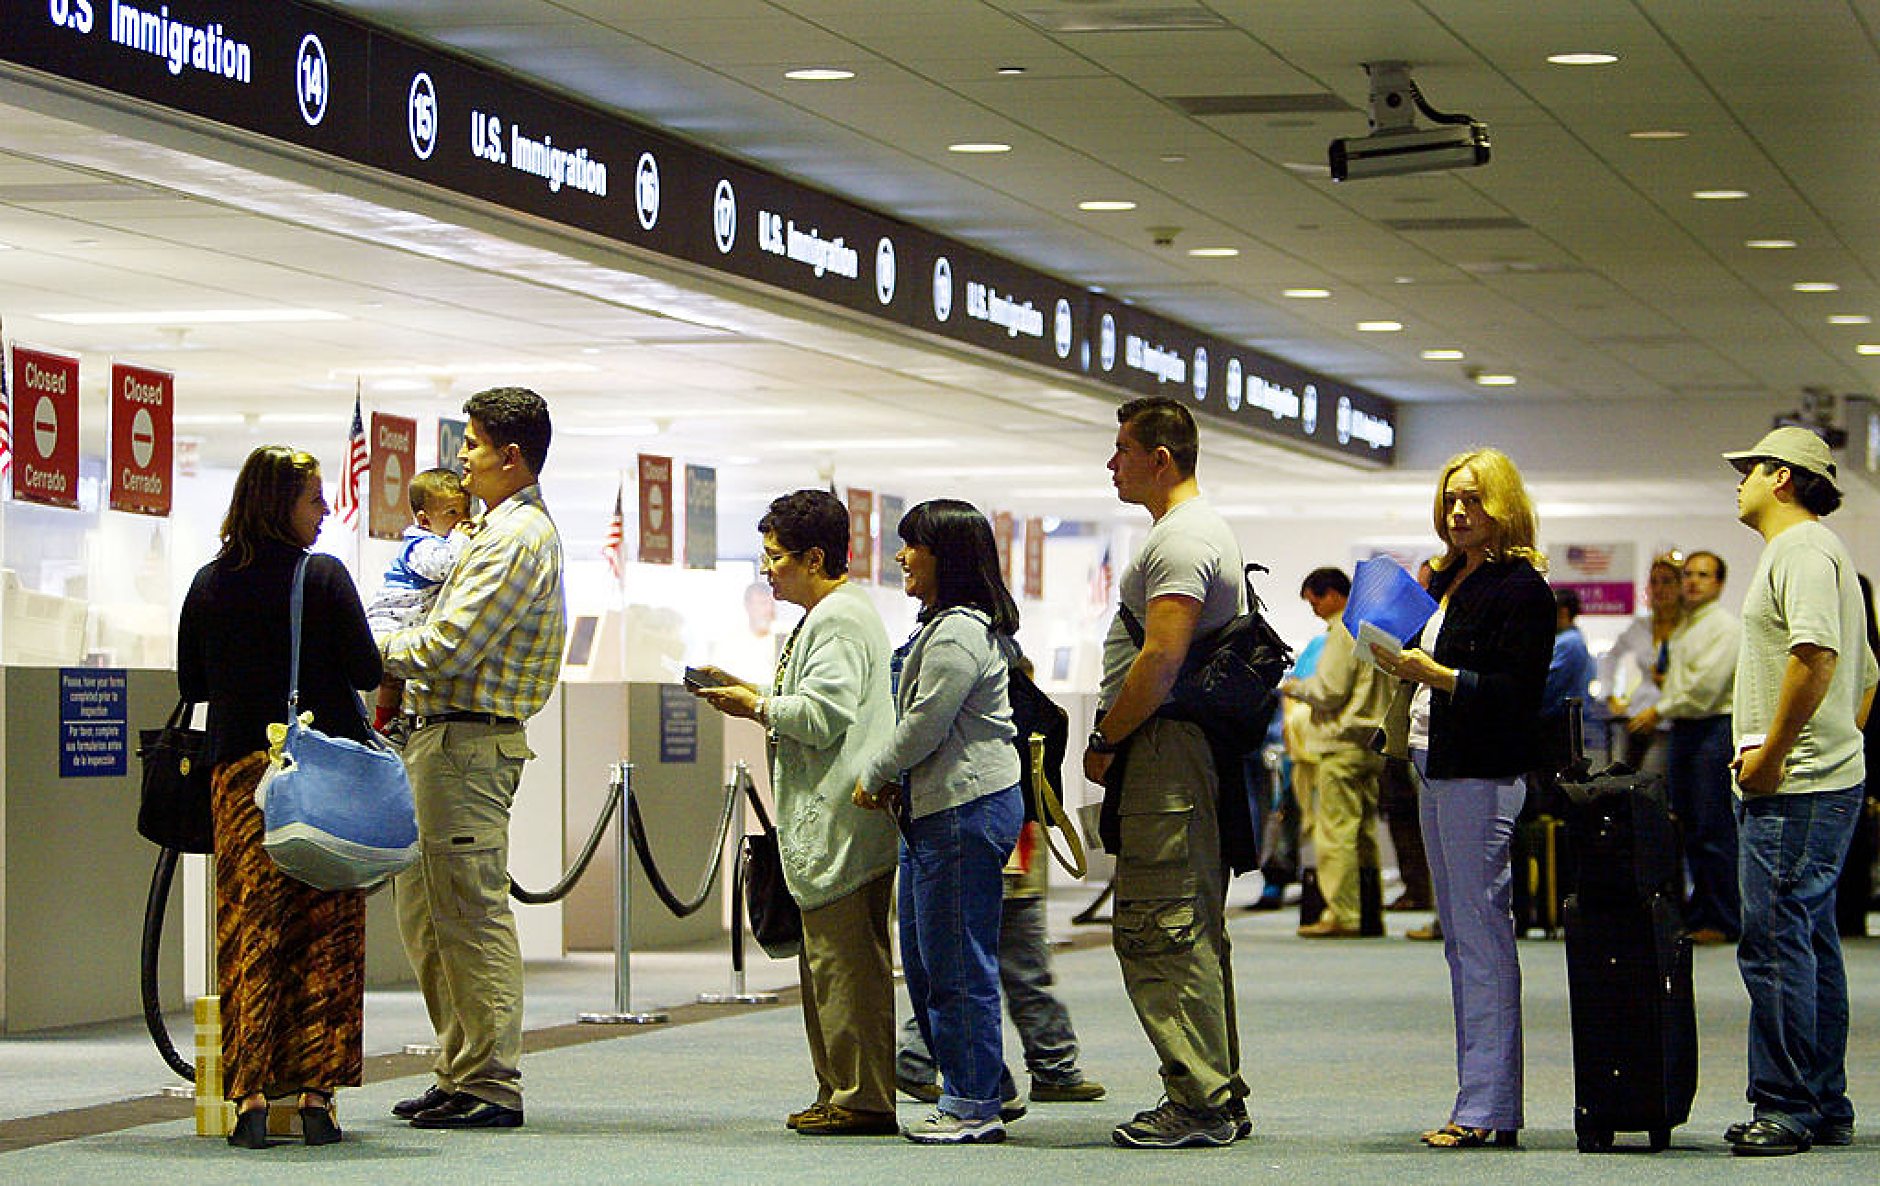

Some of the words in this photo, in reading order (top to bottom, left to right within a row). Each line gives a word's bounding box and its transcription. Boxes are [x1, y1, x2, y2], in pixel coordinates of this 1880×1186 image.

[109, 0, 251, 84] Immigration
[301, 54, 321, 106] 14
[414, 92, 432, 141] 15
[470, 109, 506, 165] U.S.
[511, 124, 607, 198] Immigration
[758, 210, 786, 256] U.S.
[25, 361, 67, 394] Closed
[124, 374, 162, 406] Closed
[25, 463, 67, 493] Cerrado
[122, 467, 162, 494] Cerrado
